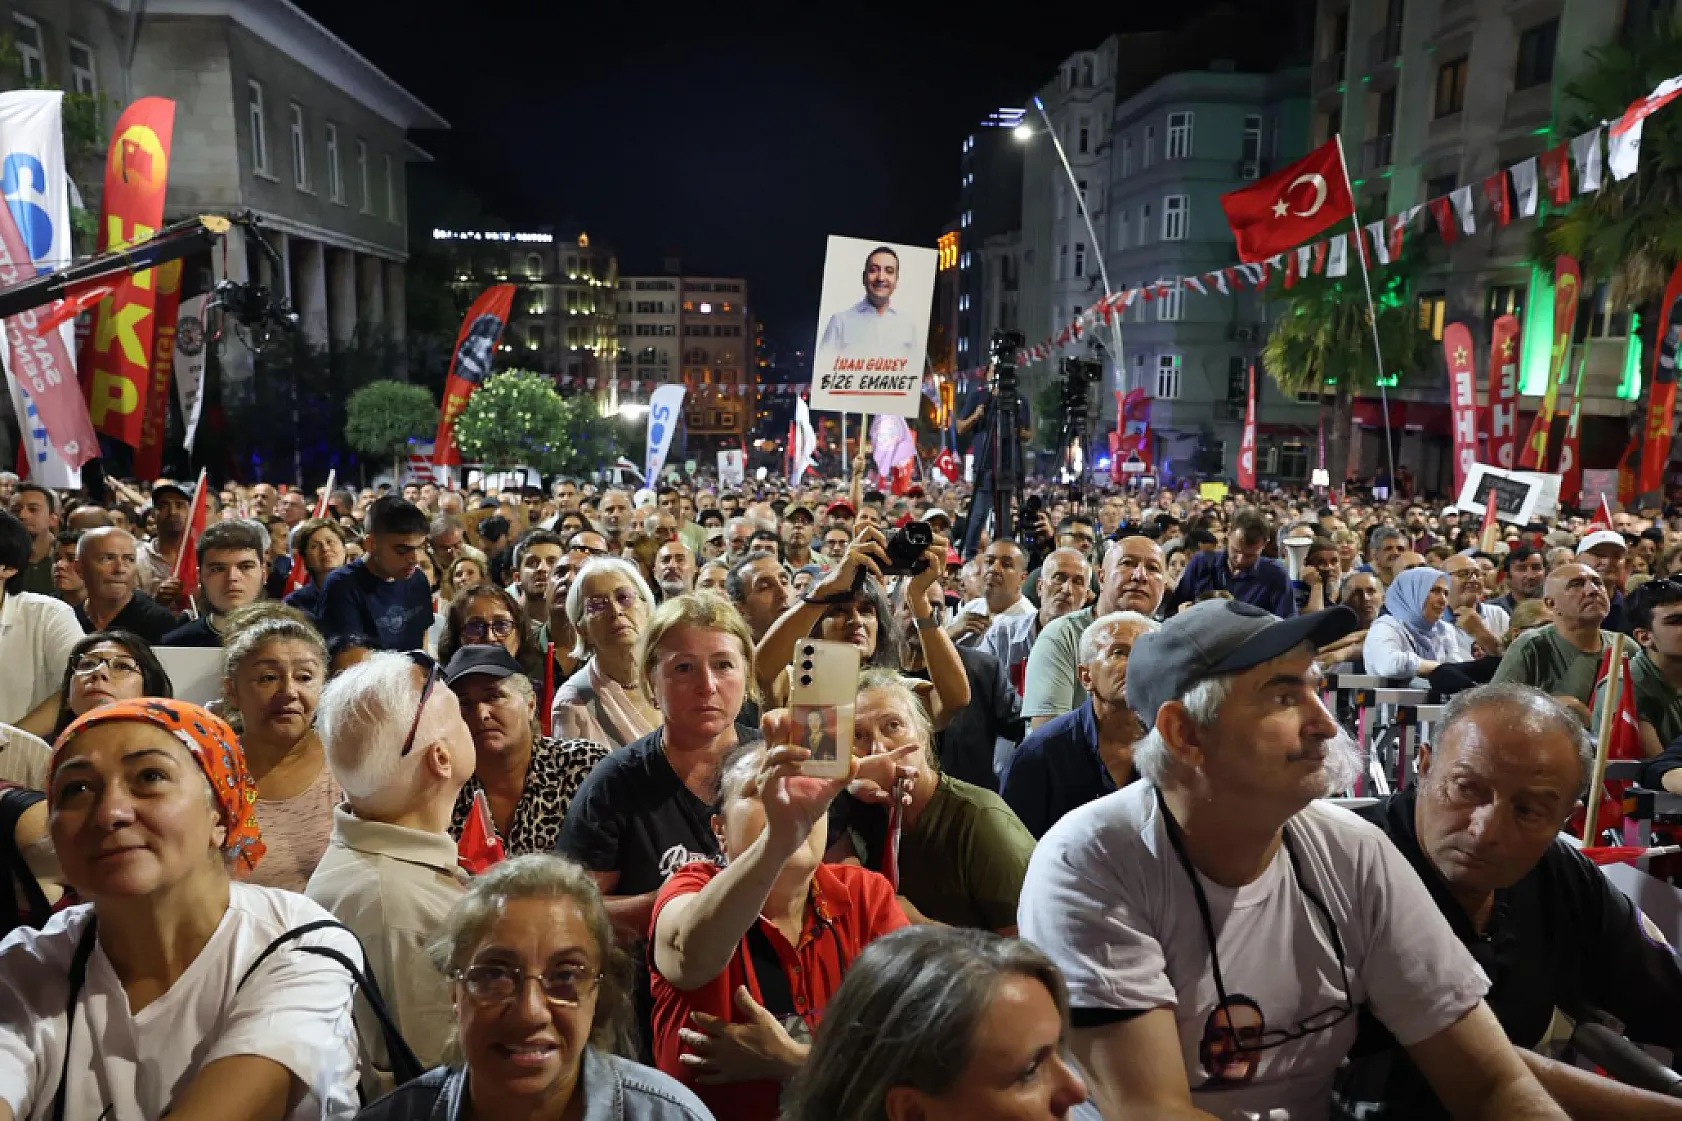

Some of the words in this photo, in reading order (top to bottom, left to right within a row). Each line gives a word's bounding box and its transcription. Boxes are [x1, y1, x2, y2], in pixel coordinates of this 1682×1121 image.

[833, 355, 865, 371] İNAN
[866, 356, 908, 371] GÜNEY
[820, 372, 855, 389] BİZE
[859, 374, 918, 390] EMANET
